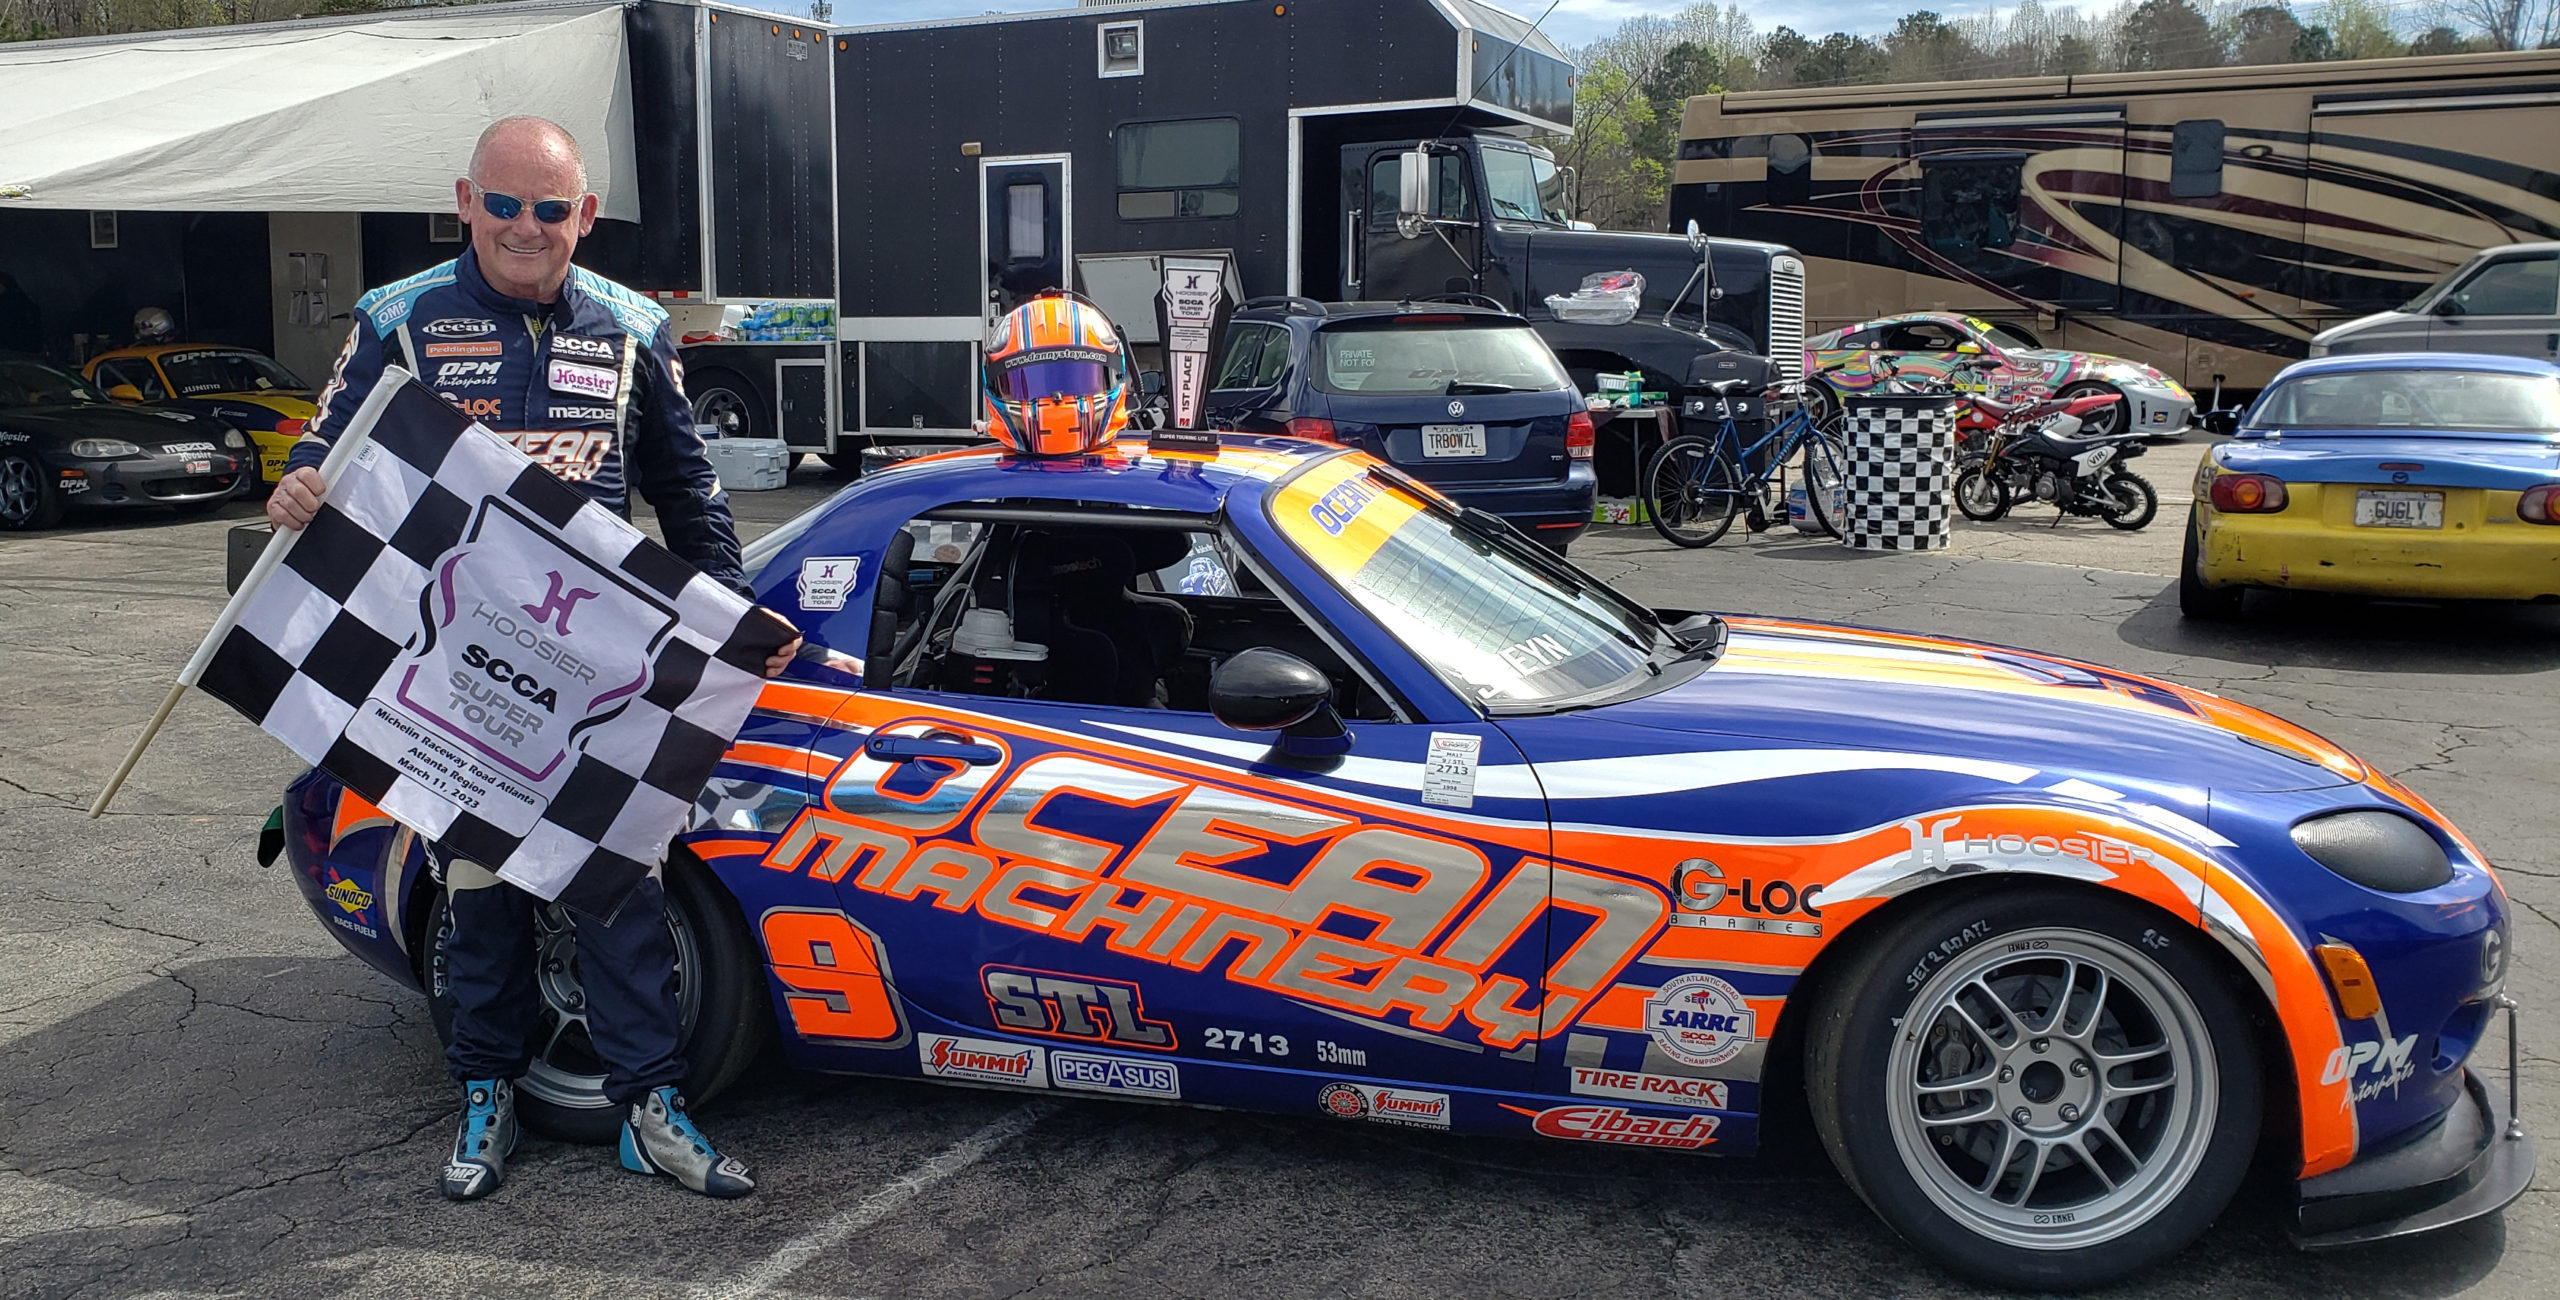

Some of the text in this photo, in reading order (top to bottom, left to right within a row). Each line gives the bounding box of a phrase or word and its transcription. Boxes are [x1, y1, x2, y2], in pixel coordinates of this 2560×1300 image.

[378, 300, 406, 324] OMP
[623, 312, 653, 334] OMP
[172, 351, 216, 363] OPM
[429, 345, 498, 354] Peddinghaus
[553, 336, 614, 356] SCCA
[1005, 349, 1107, 368] www.dannysteyn.com
[1340, 350, 1373, 358] PRIVATE
[438, 362, 502, 376] OPM
[1340, 359, 1357, 367] NOT
[434, 375, 497, 388] Autosports
[553, 368, 614, 390] Hoosier
[1182, 356, 1192, 412] 1ST PLACE
[549, 406, 615, 420] mazda
[498, 431, 613, 463] EAN
[2090, 450, 2106, 464] VIR
[60, 479, 88, 489] OPM
[1309, 479, 1376, 536] OCEAN
[2375, 500, 2426, 520] GUGLY
[472, 602, 597, 686] HOOSIER
[461, 644, 557, 714] SCCA
[449, 670, 544, 735] SUPER
[449, 691, 525, 748] TOUR
[375, 708, 535, 806] Michelin Raceway Road Atlanta
[408, 747, 486, 797] Atlanta Region
[1436, 764, 1469, 776] 2713
[397, 757, 480, 809] March 11, 2023
[822, 717, 1671, 993] OCEAN
[1964, 833, 2157, 868] HOOSIER
[328, 885, 371, 908] SUNOCO
[1669, 857, 1823, 918] G-LOC
[333, 915, 377, 939] RACE FUELS
[764, 809, 1580, 1047] MACHINERY
[1670, 914, 1822, 937] BRAKES
[760, 907, 910, 1048] 9
[1906, 957, 1930, 991] SET
[1928, 951, 1945, 962] 2
[1662, 975, 1739, 1001] SOUTH ATLANTIC ROAD
[1684, 996, 1717, 1005] SEDIV
[980, 963, 1178, 1051] STL
[1659, 1009, 1740, 1034] SARRC
[1204, 1027, 1290, 1056] 2713
[1681, 1031, 1716, 1042] SCCA
[1317, 1040, 1367, 1067] 53mm
[1658, 1039, 1739, 1065] RACING CHAMPIONSHIPS
[2321, 1034, 2419, 1086] OPM
[947, 1070, 1028, 1084] RACING EQUIPMENT
[1062, 1060, 1170, 1089] PEGASUS
[1321, 1085, 1338, 1104] SPORTS
[1340, 1085, 1355, 1093] CAR
[1356, 1093, 1367, 1108] CLUB
[1575, 1069, 1722, 1108] TIRE RACK
[1668, 1095, 1709, 1106] .com
[2339, 1060, 2415, 1116] Autosports
[1367, 1116, 1450, 1131] ROAD RACING
[1534, 1106, 1714, 1140] Eibach
[2052, 1212, 2076, 1224] ENKEI
